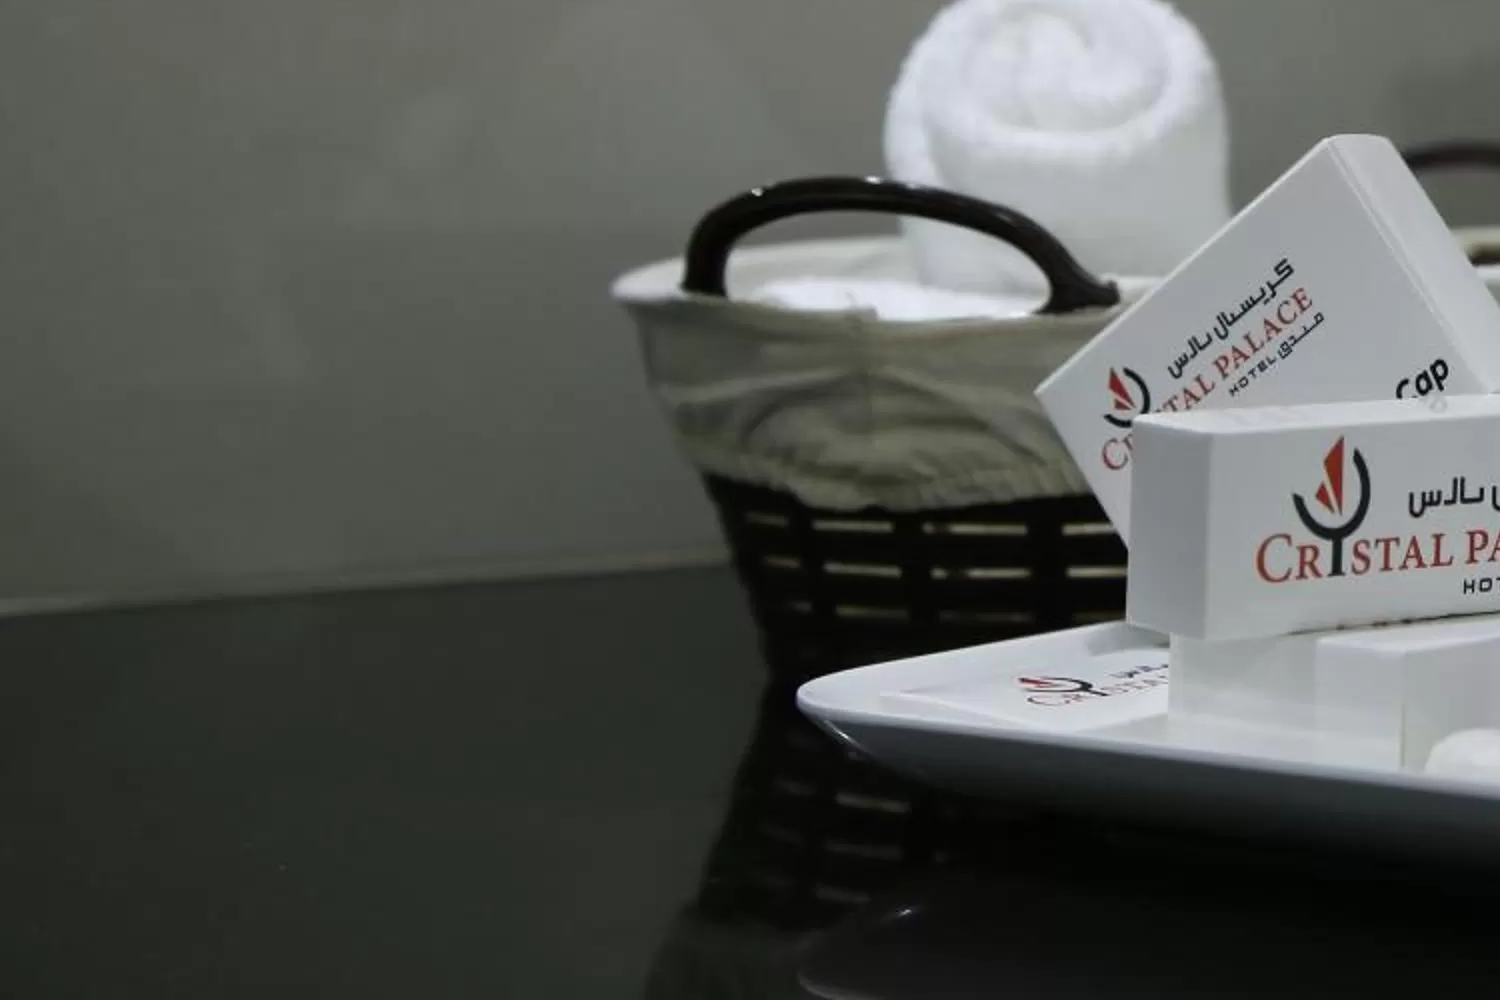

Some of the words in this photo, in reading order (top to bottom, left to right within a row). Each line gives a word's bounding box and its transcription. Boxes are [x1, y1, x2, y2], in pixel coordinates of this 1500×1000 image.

[1212, 287, 1312, 381] PALACE
[1229, 354, 1277, 397] HOTEL
[1396, 358, 1448, 399] Cap
